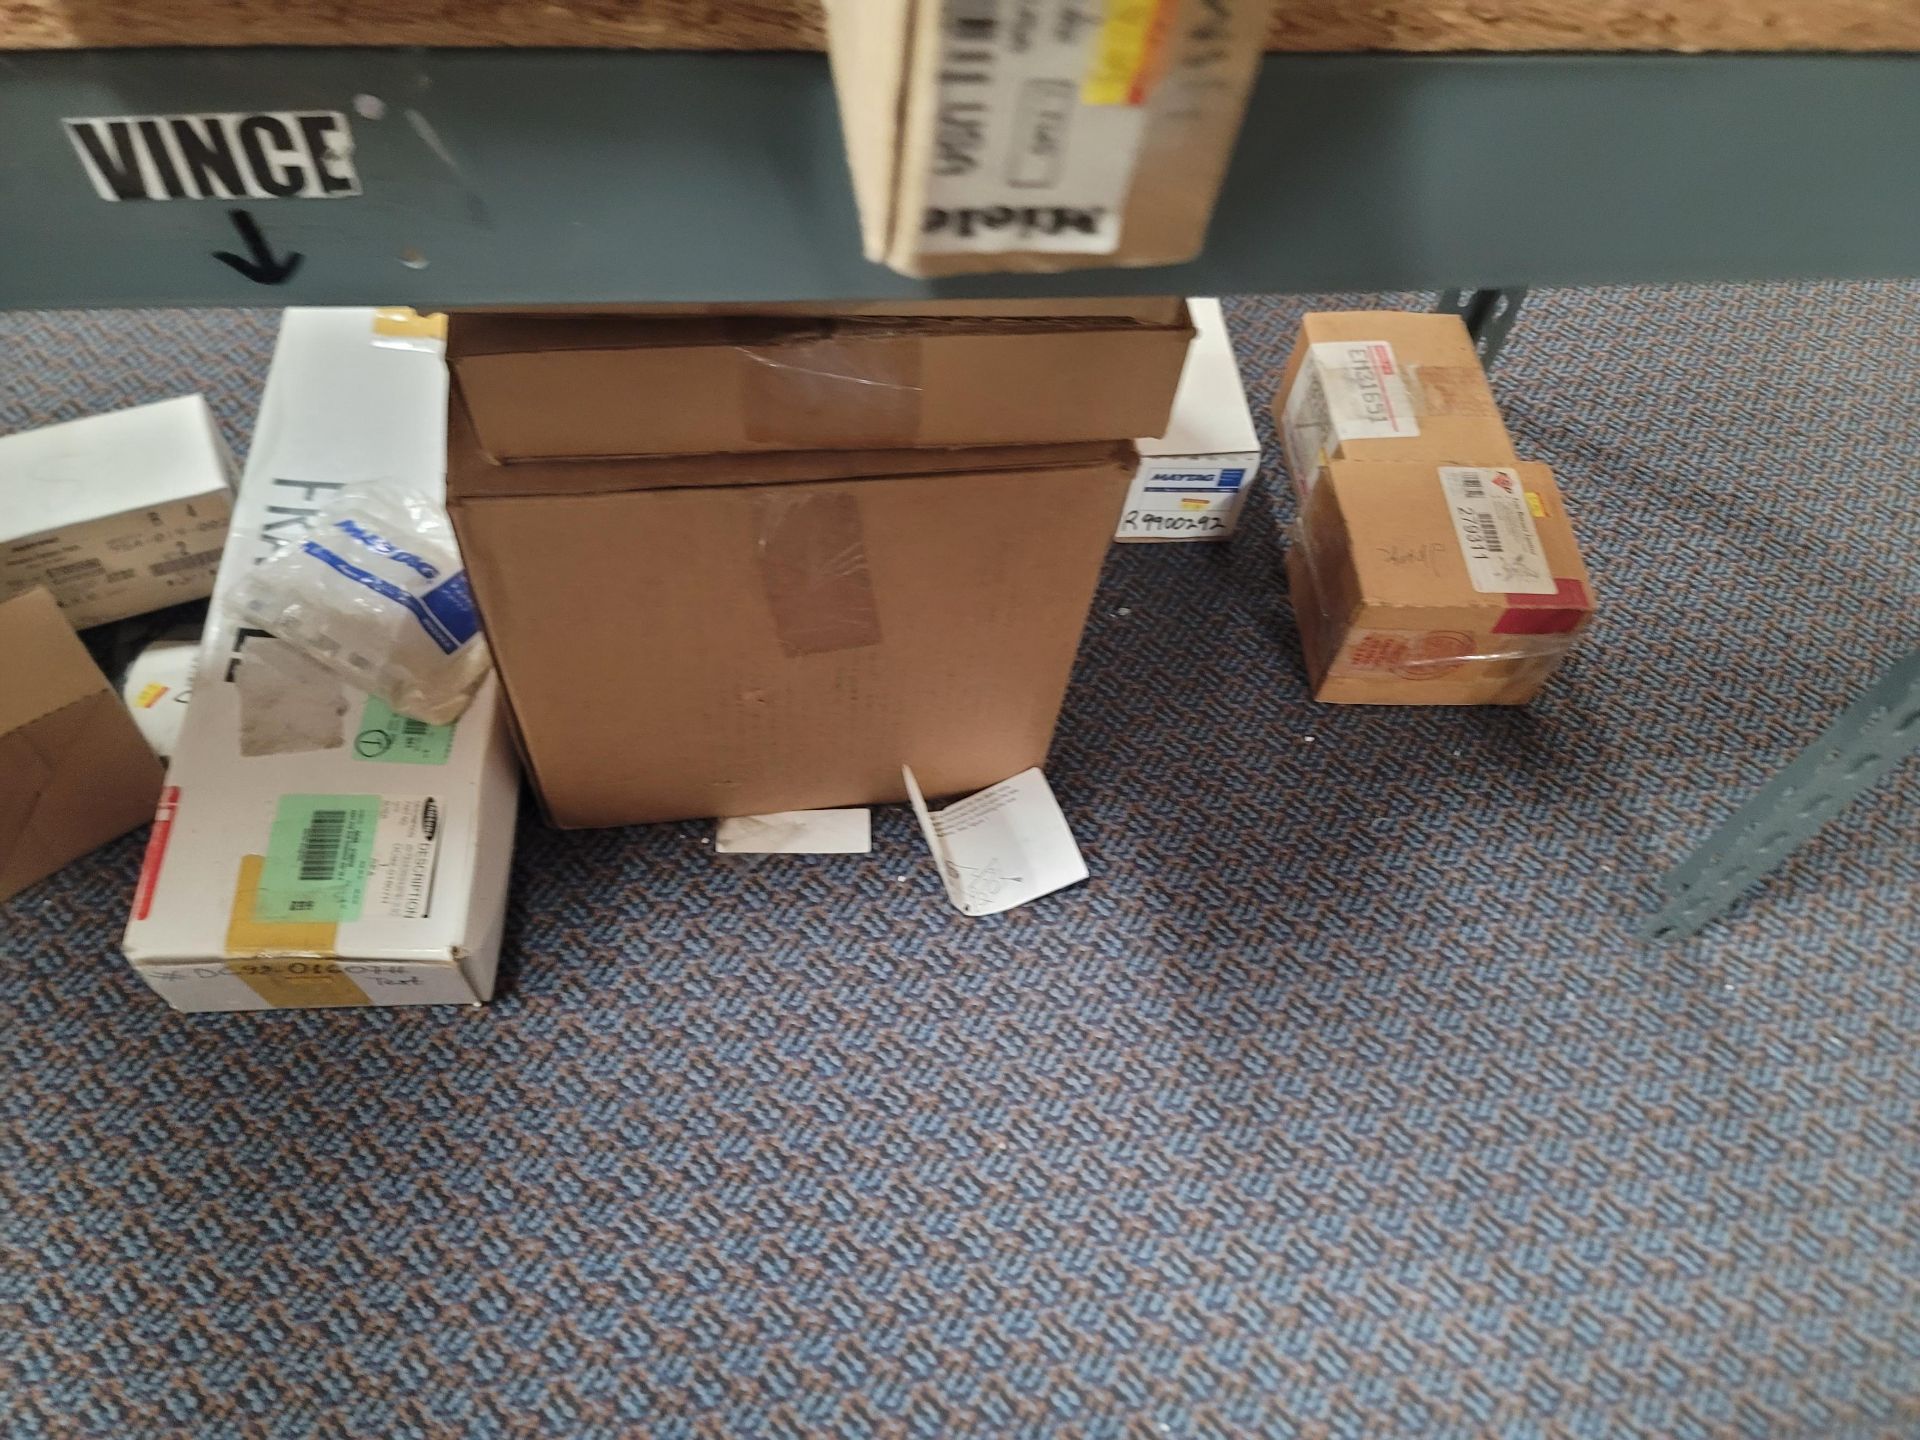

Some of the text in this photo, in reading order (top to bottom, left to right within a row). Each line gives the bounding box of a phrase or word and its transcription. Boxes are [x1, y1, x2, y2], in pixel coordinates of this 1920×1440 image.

[73, 114, 353, 200] VINCE
[1151, 473, 1216, 482] MAYTAG
[1457, 507, 1485, 560] 279311
